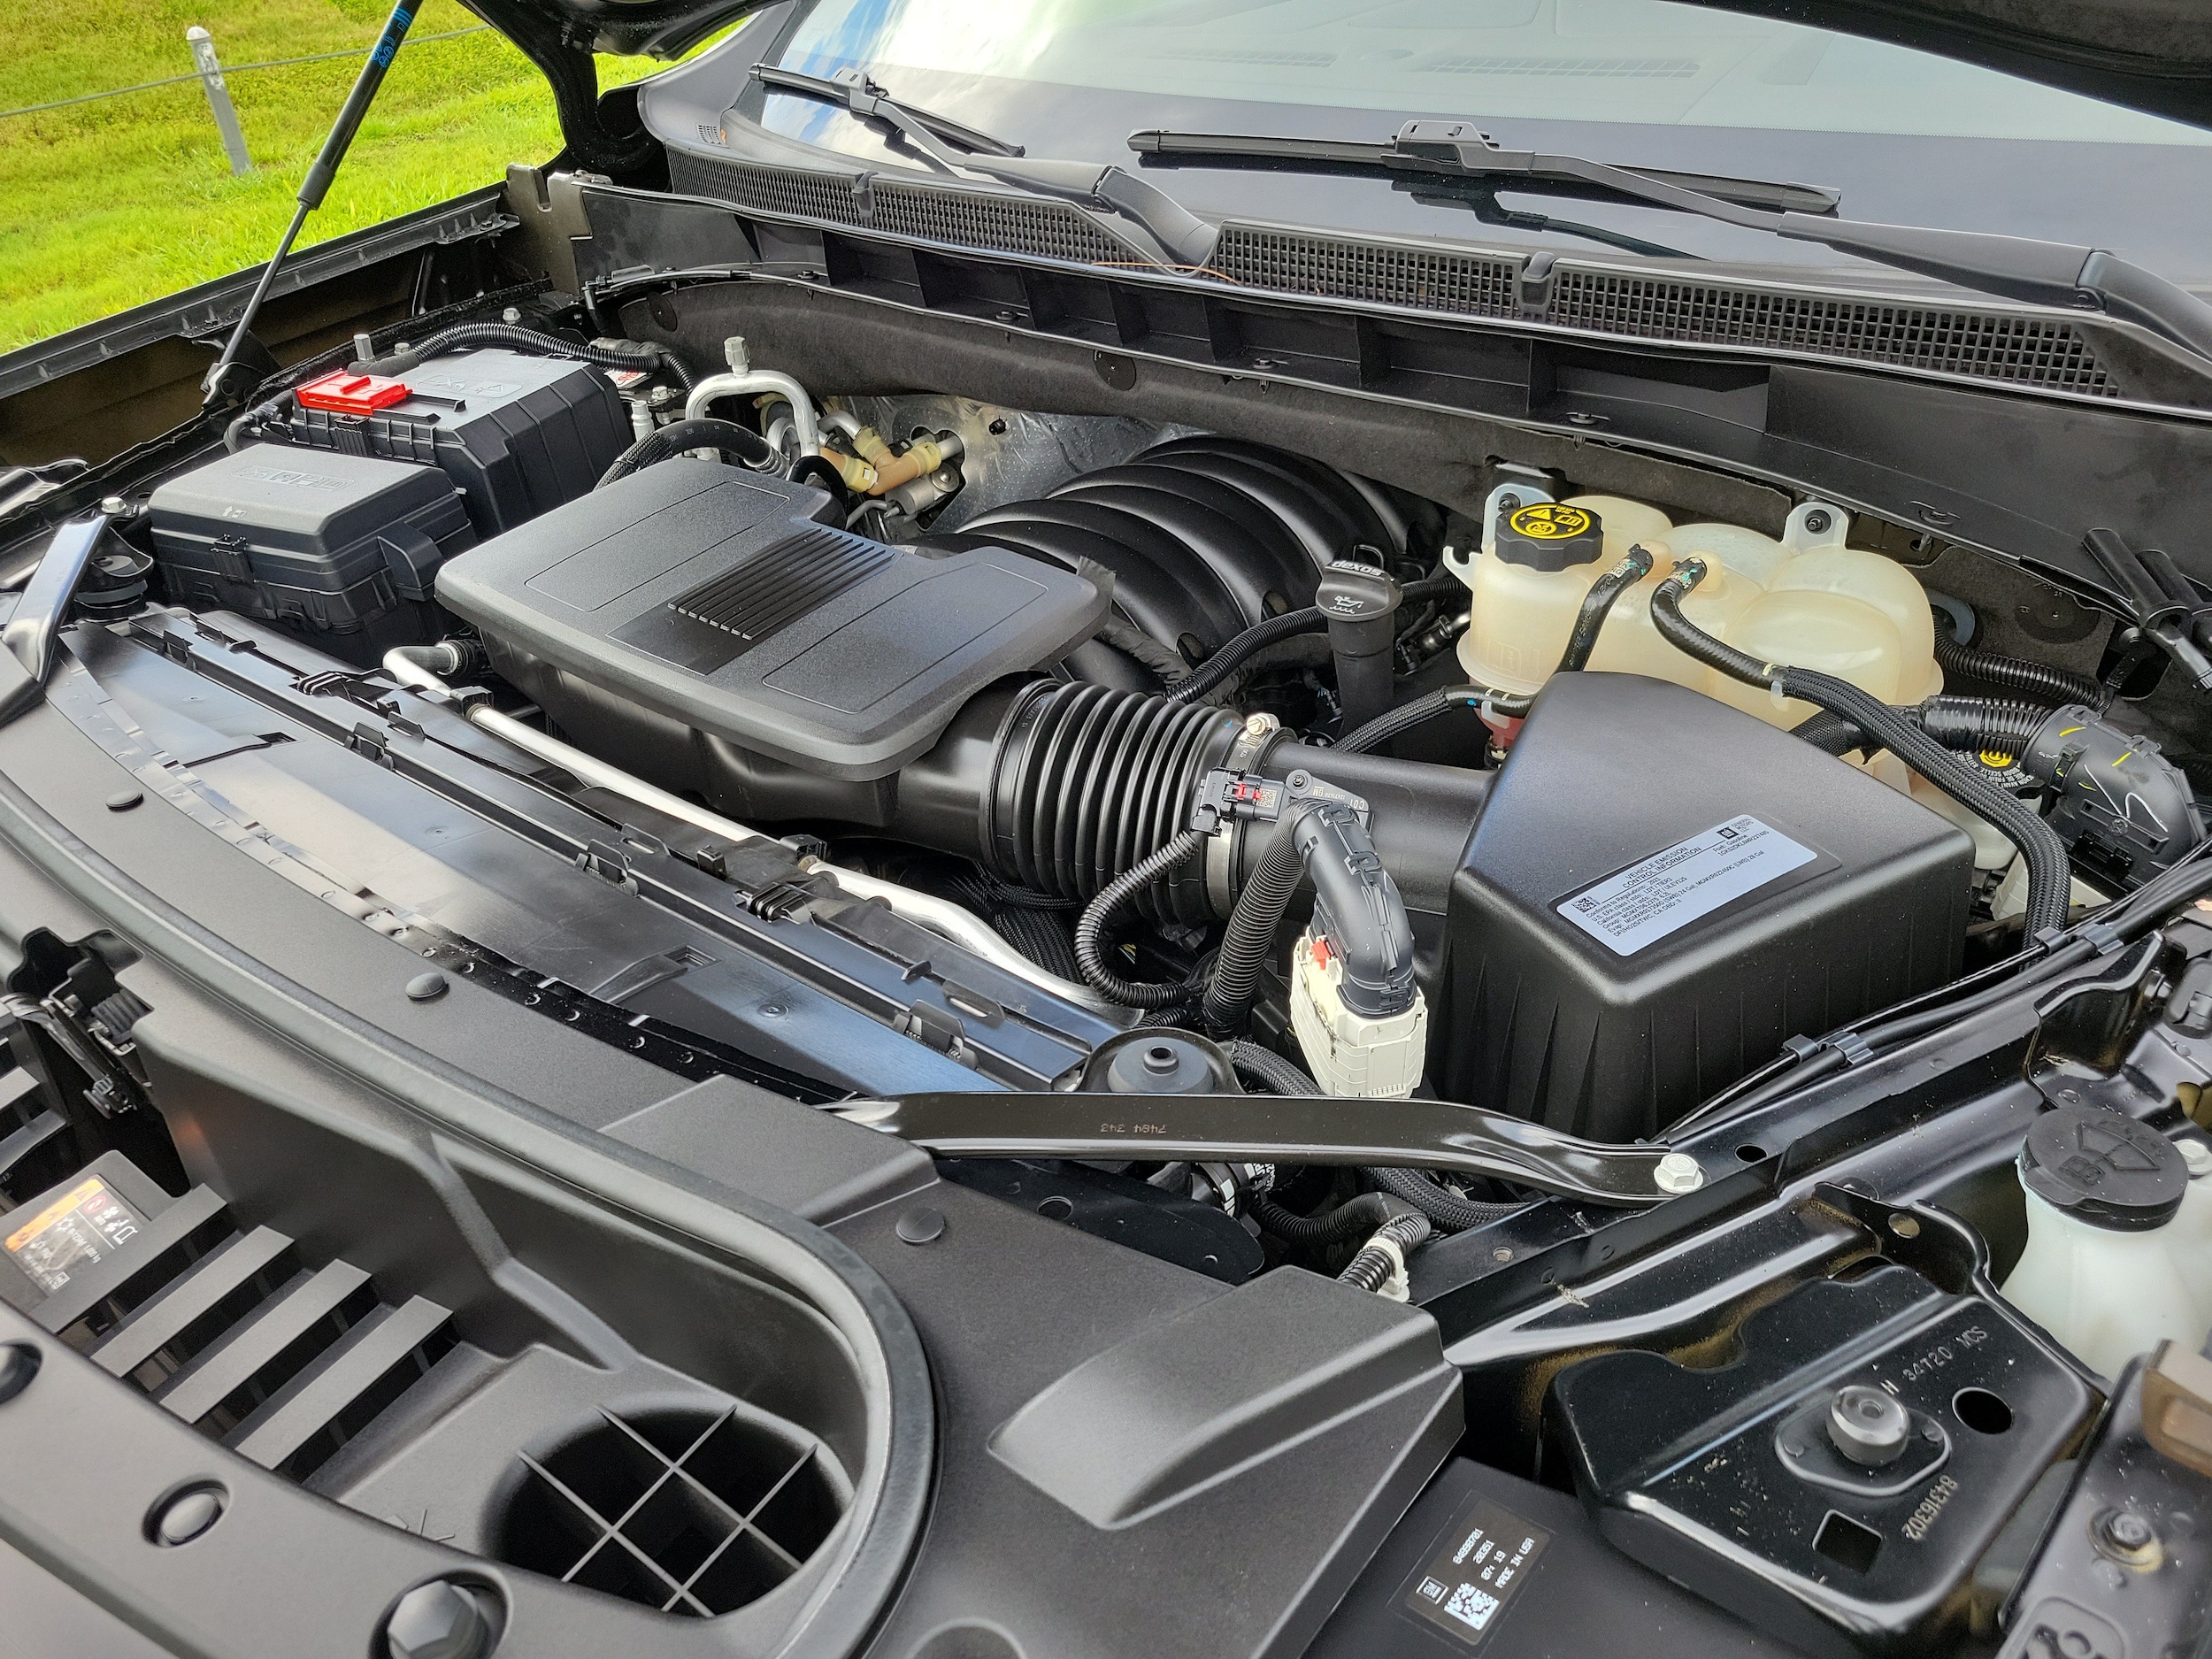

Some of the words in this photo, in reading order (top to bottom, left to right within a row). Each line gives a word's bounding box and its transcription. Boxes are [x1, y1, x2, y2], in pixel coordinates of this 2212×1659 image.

[1331, 560, 1386, 577] dexos
[1313, 786, 1324, 796] GM
[1622, 870, 1656, 887] CONTROL
[1655, 847, 1701, 871] INFORMATION
[1624, 863, 1655, 879] VEHICLE
[1654, 847, 1687, 864] EMISSION
[1585, 902, 1611, 917] Conforms
[1615, 884, 1647, 902] Regulations:
[1628, 892, 1643, 901] stds:
[1595, 910, 1622, 925] California
[1601, 918, 1621, 928] Group:
[1607, 923, 1624, 932] Evap:
[1494, 1566, 1514, 1589] MADE
[1509, 1554, 1523, 1567] IN
[1518, 1537, 1535, 1555] USA
